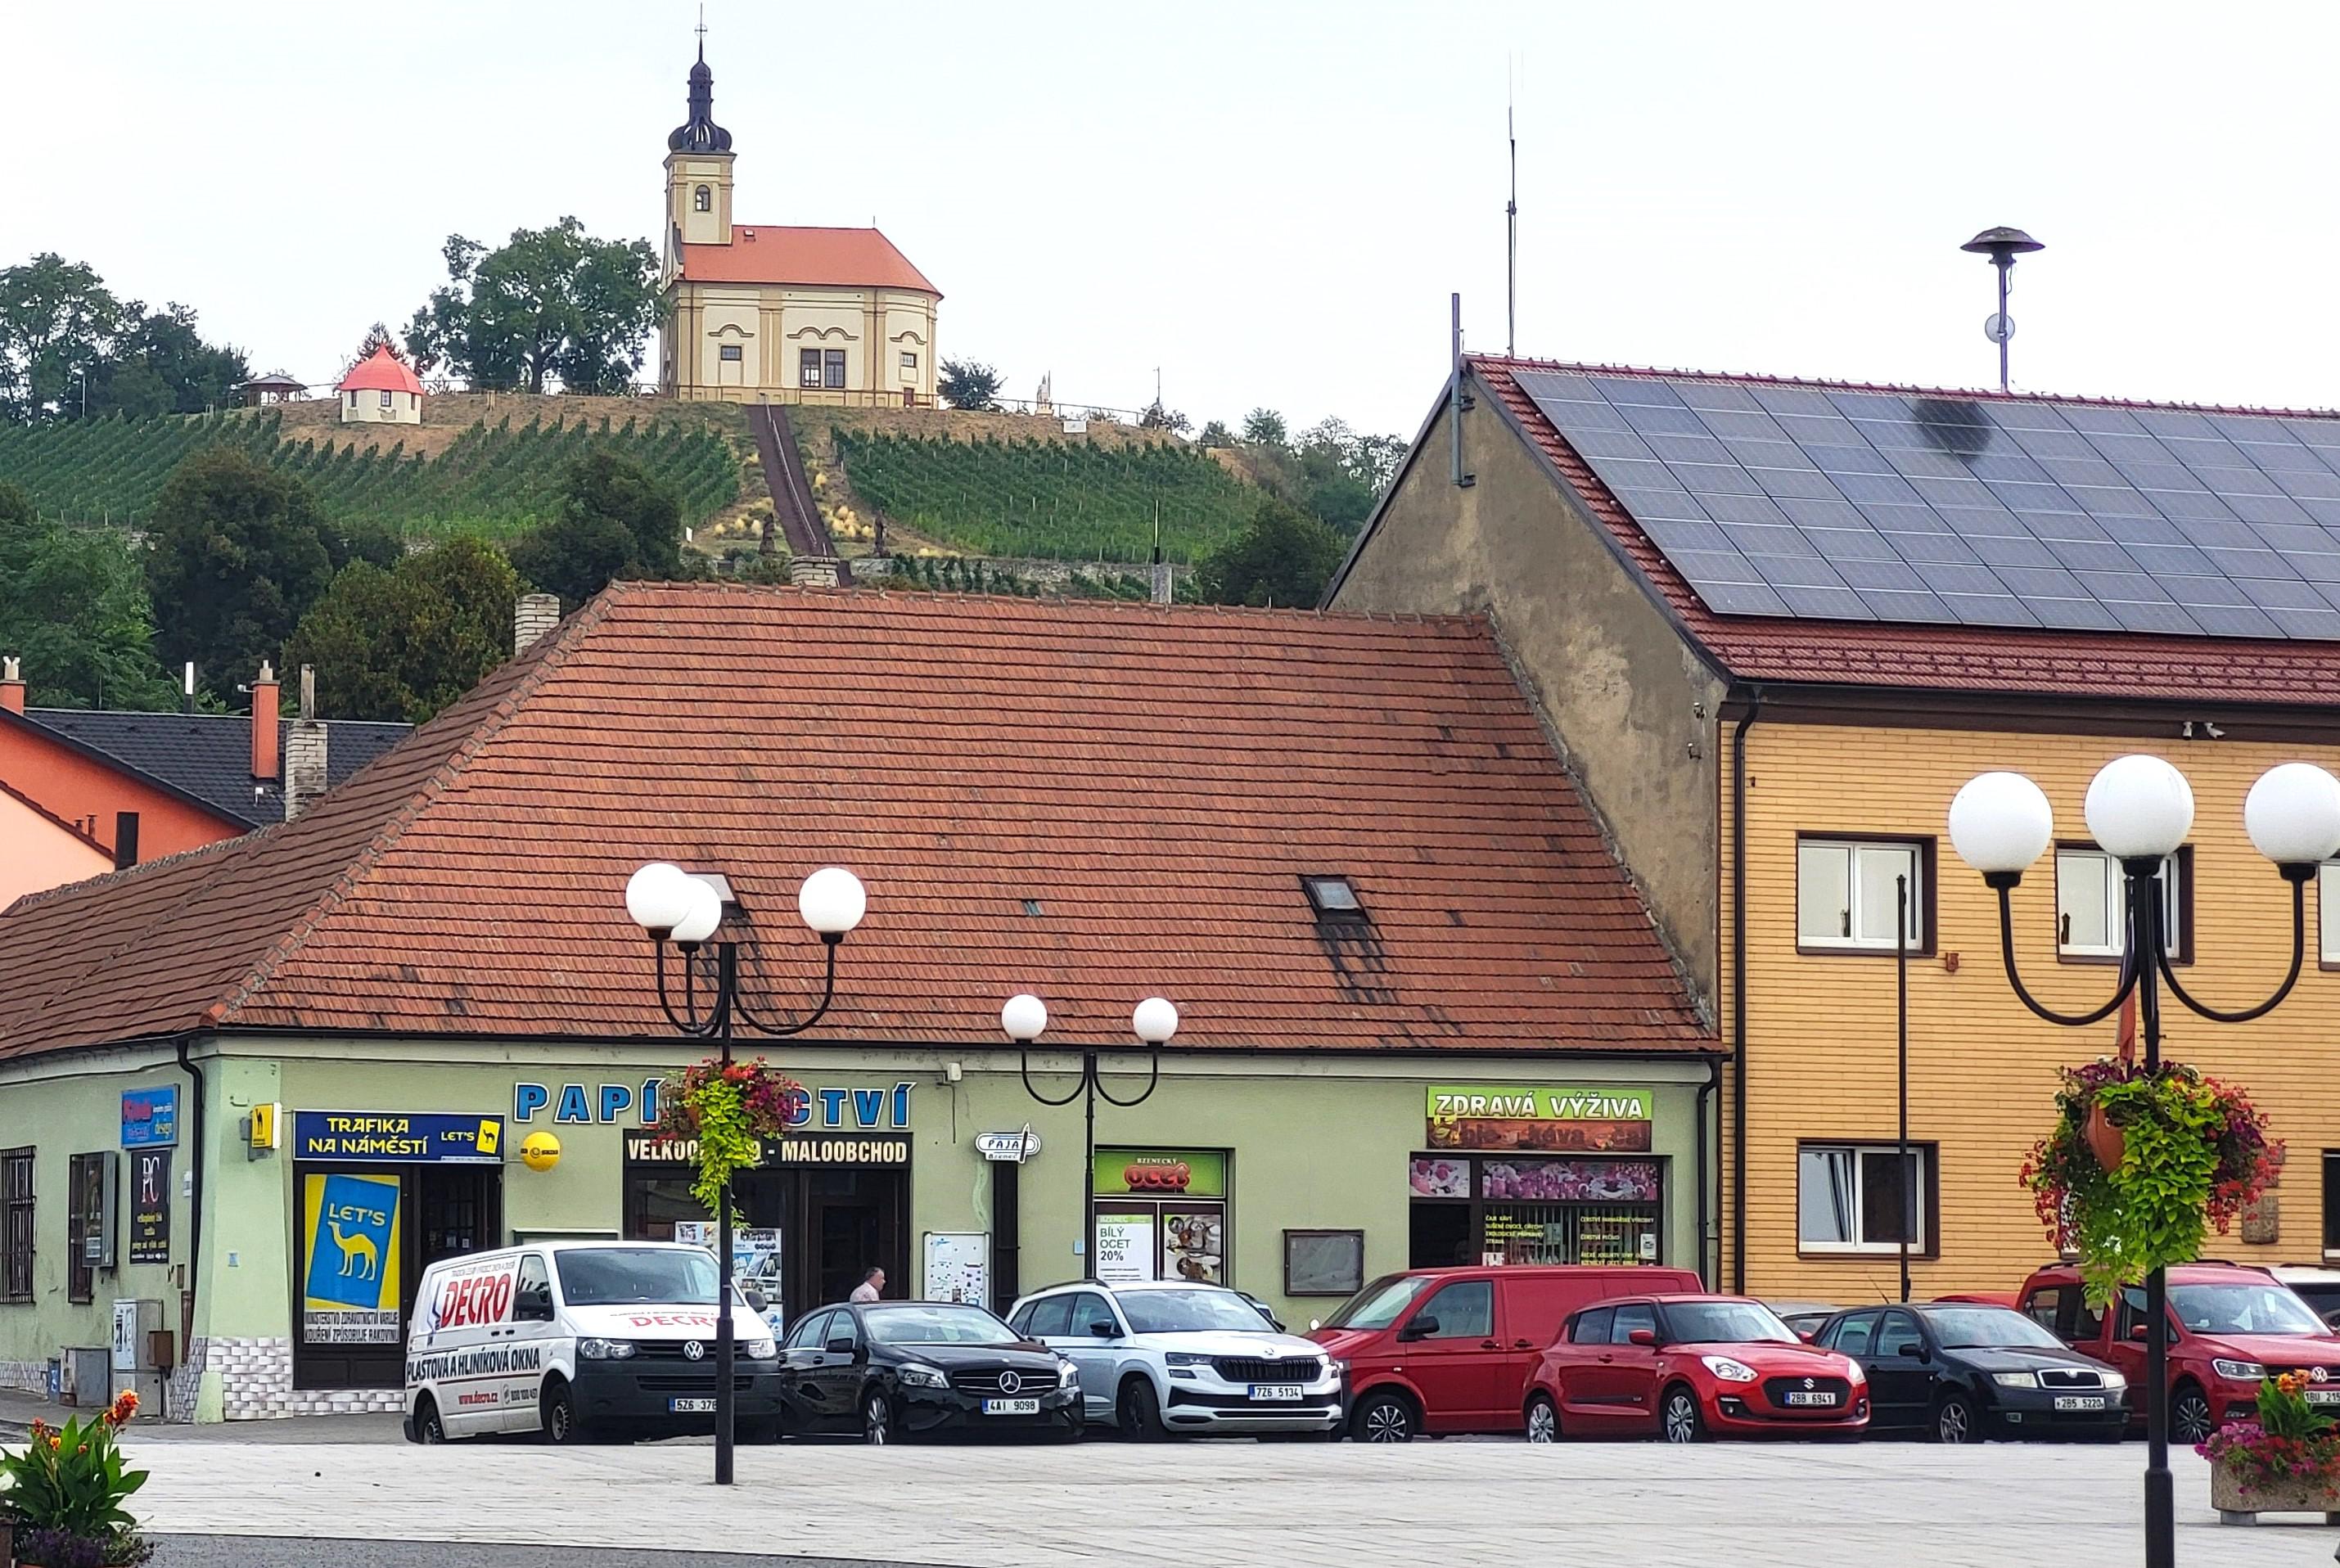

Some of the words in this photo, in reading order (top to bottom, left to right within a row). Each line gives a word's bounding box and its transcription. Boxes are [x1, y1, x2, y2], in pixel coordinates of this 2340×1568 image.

[513, 1077, 917, 1129] PAPÍCTVÍ
[1435, 1091, 1538, 1117] ZDRAVÁ
[1549, 1092, 1645, 1120] VÝŽIVA
[327, 1118, 409, 1133] TRAFIKA
[441, 1132, 475, 1142] LET'S
[309, 1138, 336, 1153] NA
[341, 1135, 429, 1155] NÁMĚSTÍ
[781, 1141, 907, 1163] MALOOBCHOD
[328, 1203, 385, 1226] LET'S
[1100, 1226, 1125, 1237] BÍLÝ
[1100, 1239, 1131, 1249] OCET
[1101, 1250, 1124, 1261] 20%
[440, 1273, 512, 1329] DECRO
[629, 1316, 717, 1327] DECR
[406, 1351, 450, 1382] PLASTOVÁ
[449, 1356, 458, 1377] A
[458, 1344, 511, 1377] HLINÍKOVÁ
[511, 1347, 541, 1370] OKNA
[1256, 1387, 1273, 1397] 7Z6
[1278, 1387, 1298, 1397] 5134
[1811, 1394, 1832, 1404] 6941
[677, 1400, 694, 1410] 5Z6
[1013, 1400, 1035, 1411] 9098
